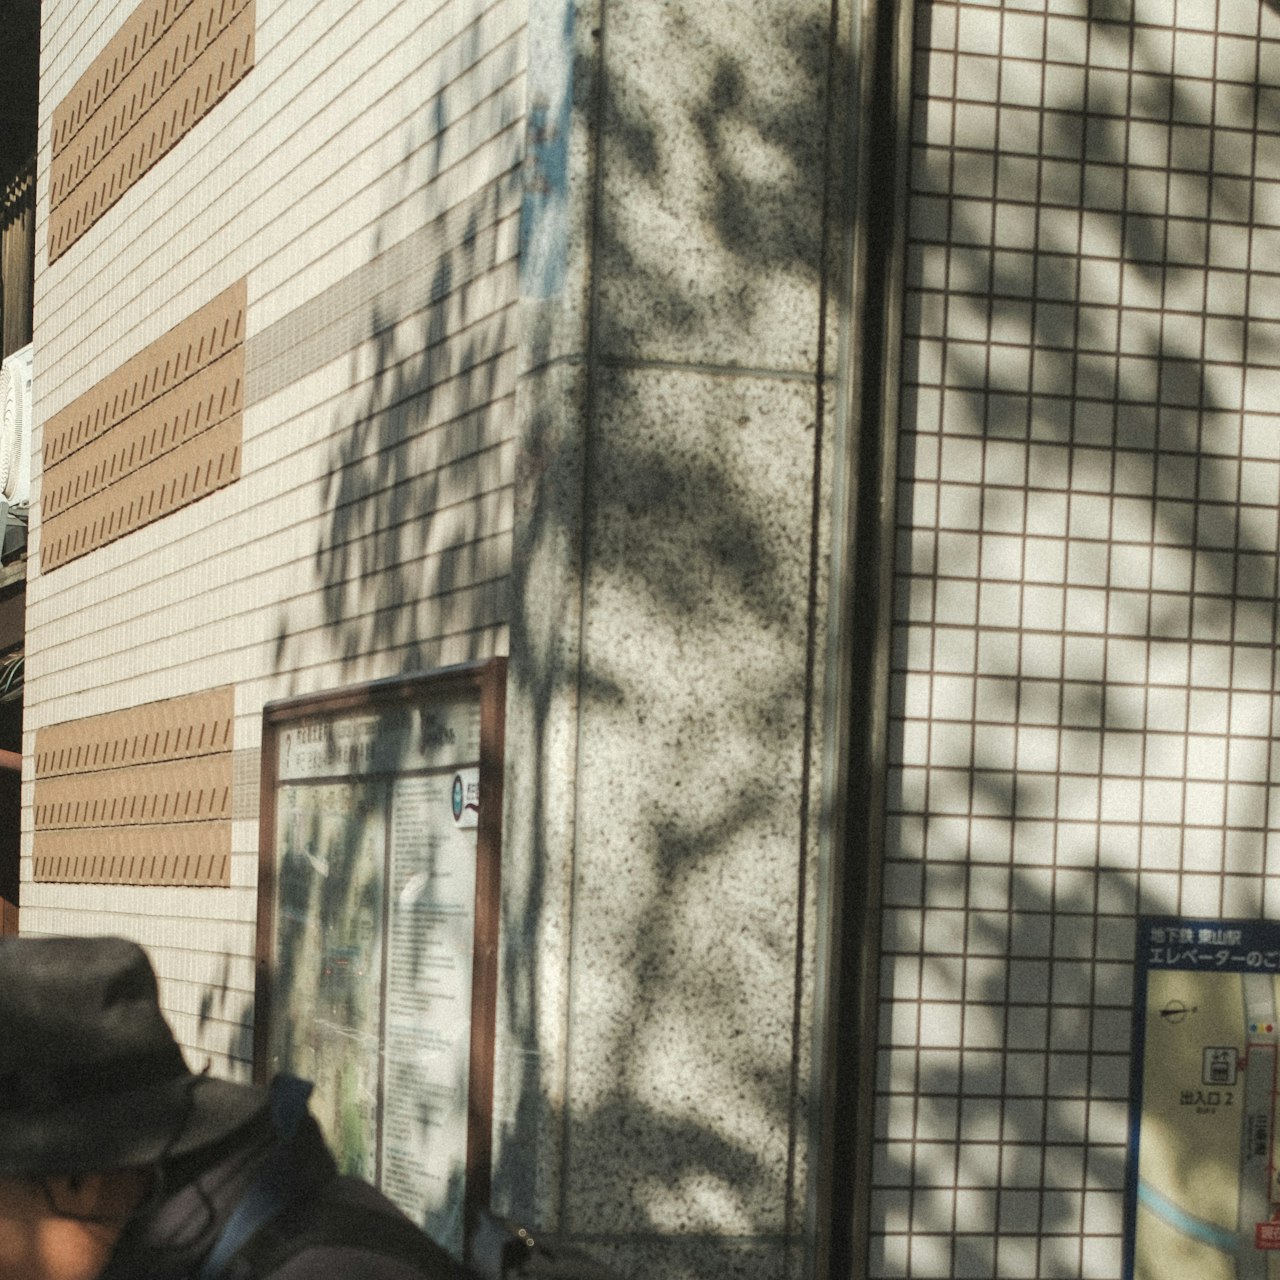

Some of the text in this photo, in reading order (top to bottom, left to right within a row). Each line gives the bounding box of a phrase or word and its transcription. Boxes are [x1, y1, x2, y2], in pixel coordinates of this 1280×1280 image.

[1150, 927, 1242, 946] 地下鉄 東山駅
[1180, 1091, 1234, 1106] 出入口 2
